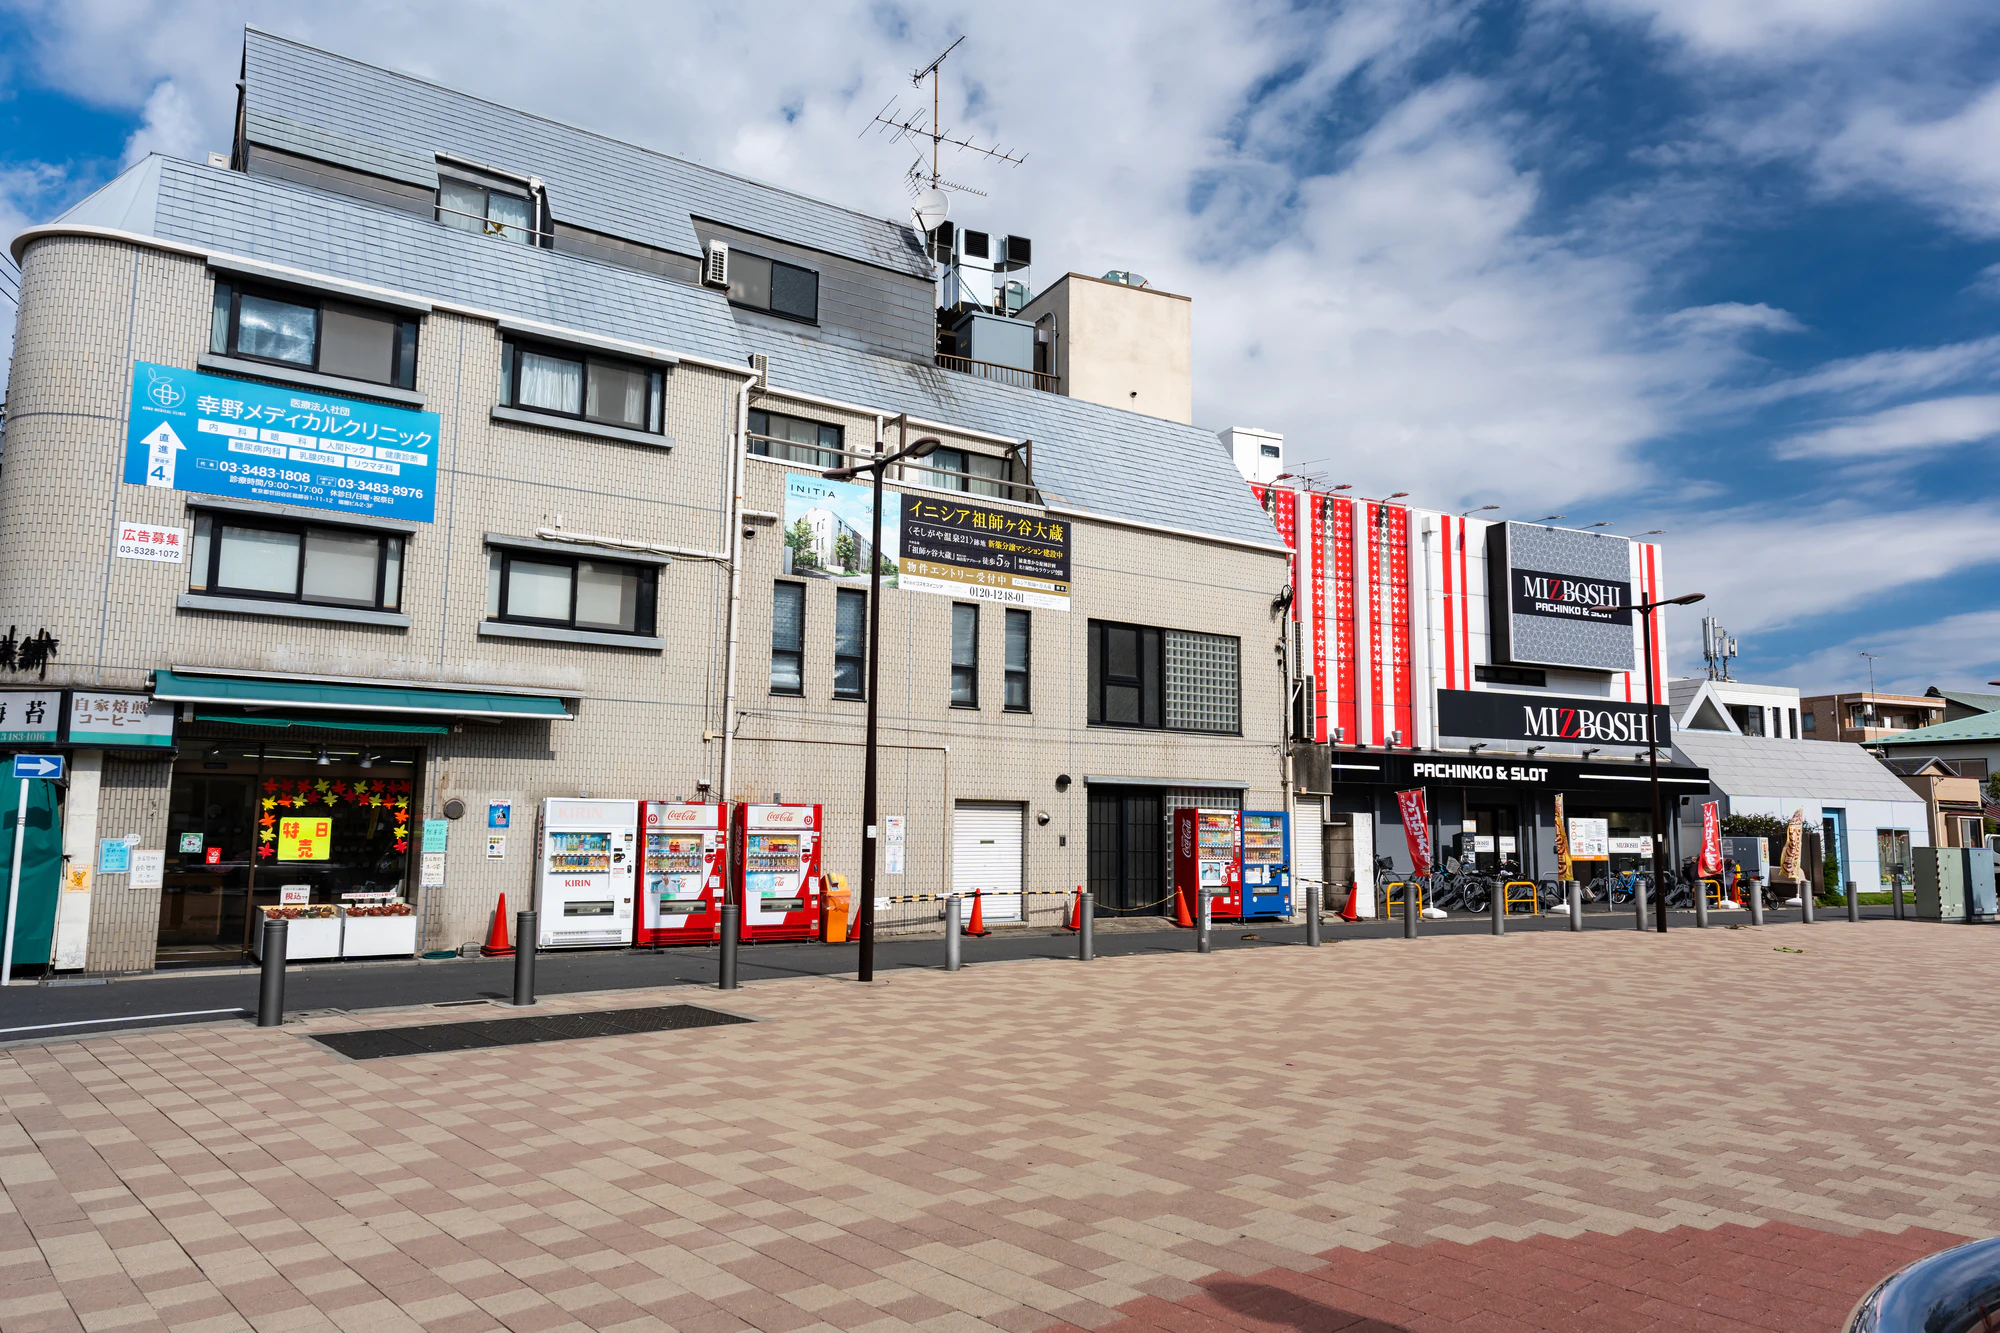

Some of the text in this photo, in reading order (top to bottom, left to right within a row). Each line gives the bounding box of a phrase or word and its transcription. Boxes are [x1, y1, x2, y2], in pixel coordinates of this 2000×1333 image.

[290, 398, 350, 416] 医療法人社団
[197, 395, 432, 448] 幸野メディカルクリニック
[209, 423, 247, 436] 内科
[158, 433, 170, 454] 直進
[270, 432, 307, 445] 眼科
[235, 442, 281, 456] 糖尿病内科
[327, 441, 366, 454] 人間ドック
[299, 451, 335, 464] 乳腺内科
[385, 450, 418, 462] 健康診断
[219, 461, 311, 483] 03-3483-1808
[354, 459, 393, 473] リウマチ科
[337, 477, 424, 499] 03-3483-8976
[790, 484, 836, 498] INITIA
[908, 500, 1064, 543] イニシア祖師ヶ谷大蔵
[122, 529, 179, 547] 広告募集
[120, 545, 180, 559] 03-5328-1072
[988, 540, 1063, 560] 新築分譲マンション建設中
[982, 554, 1011, 568] 徒歩5分
[906, 561, 1007, 586] 物件エントリー受付中
[969, 586, 1025, 603] 0120-1248-01
[1523, 575, 1621, 607] MIZBOSHI
[1535, 602, 1581, 616] PACHINKO
[1582, 607, 1590, 616] &
[75, 698, 147, 716] 自家焙煎
[79, 714, 142, 729] コーヒー
[1523, 705, 1659, 743] MIZBOSHI
[1413, 762, 1548, 782] PACHINKO & SLOT
[558, 806, 603, 819] KIRIN
[564, 879, 591, 887] KIRIN
